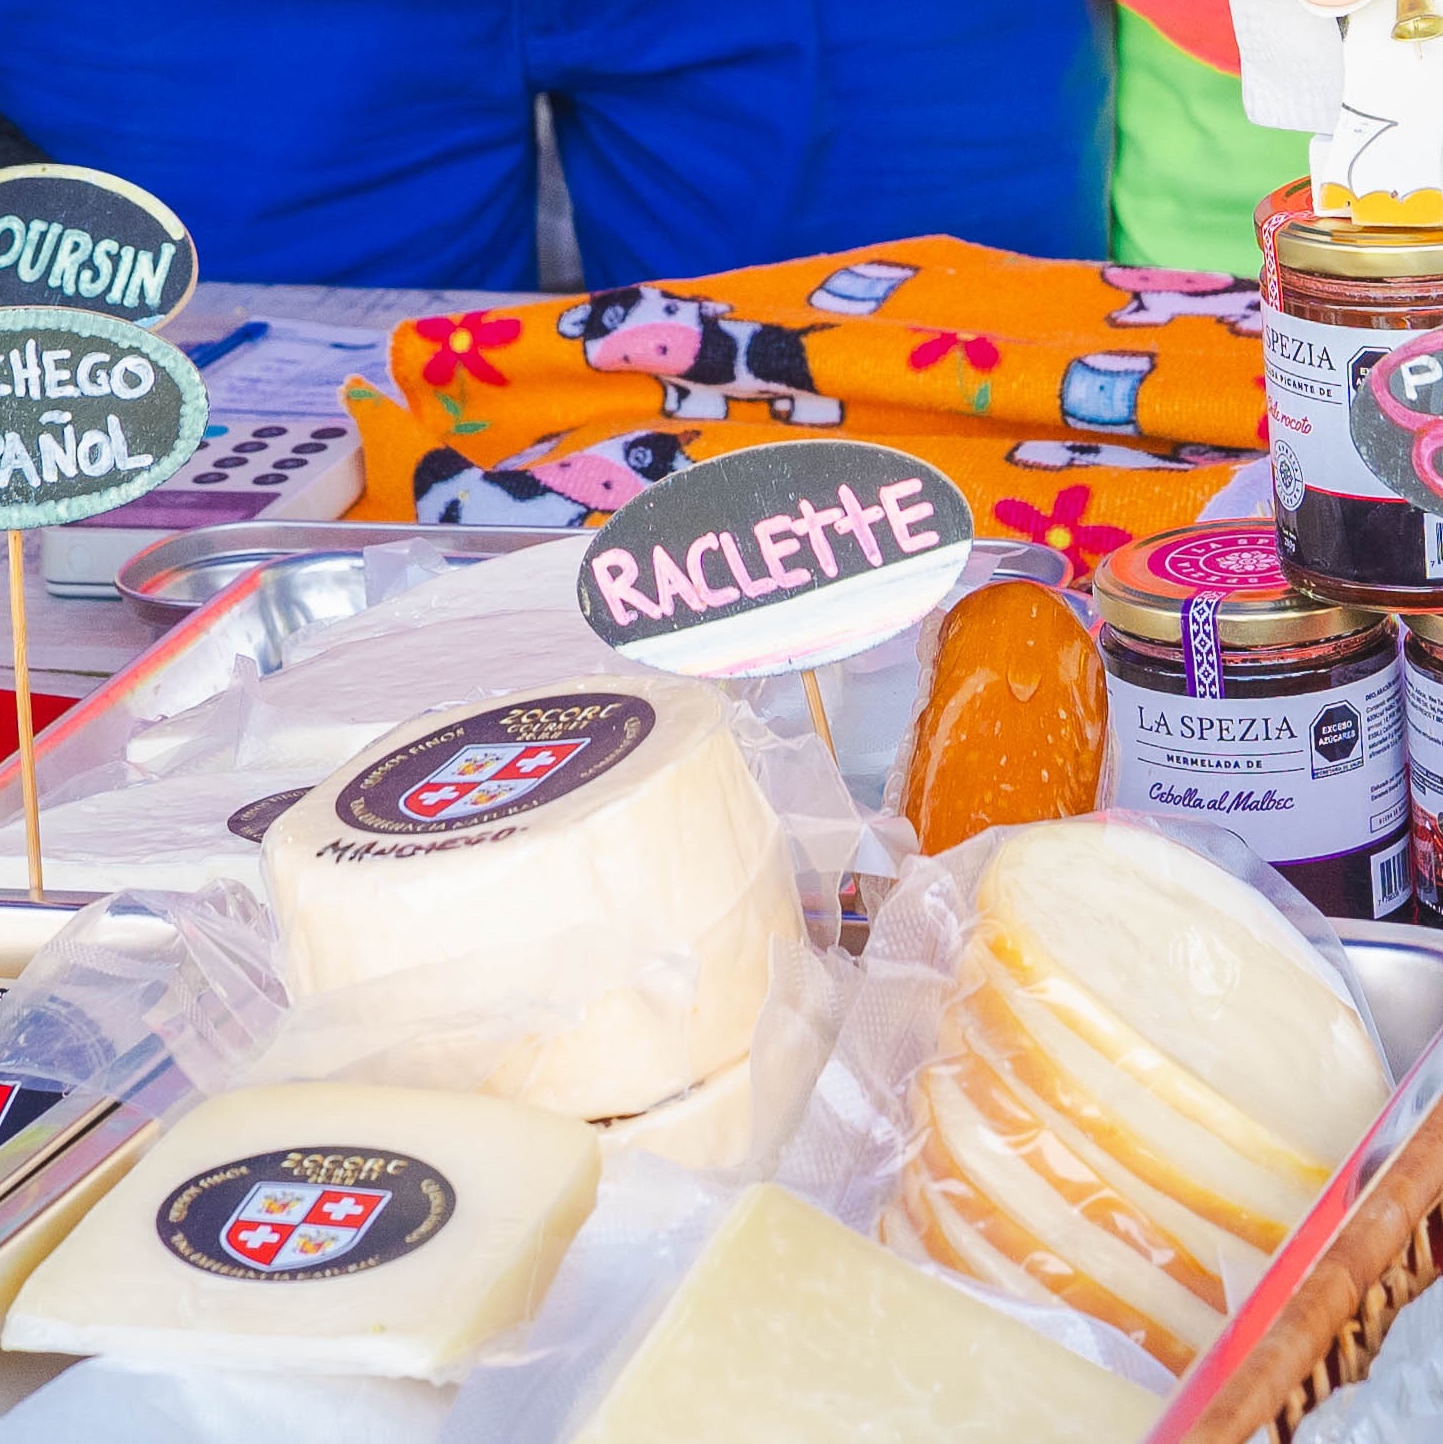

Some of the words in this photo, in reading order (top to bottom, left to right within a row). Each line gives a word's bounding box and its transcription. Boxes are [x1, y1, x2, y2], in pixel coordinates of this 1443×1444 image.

[1280, 375, 1316, 396] PICANTE
[1319, 388, 1333, 398] DE
[1281, 416, 1313, 435] rocoto
[590, 477, 941, 628] RACLETTE
[1137, 705, 1174, 737] LA
[1180, 715, 1298, 743] SPEZIA
[1322, 720, 1353, 734] EXCESO
[1166, 753, 1241, 770] MERMELADA
[1247, 760, 1263, 769] DE
[1149, 782, 1205, 809] Cebolla
[1207, 792, 1229, 811] al
[1226, 789, 1295, 813] Malbec
